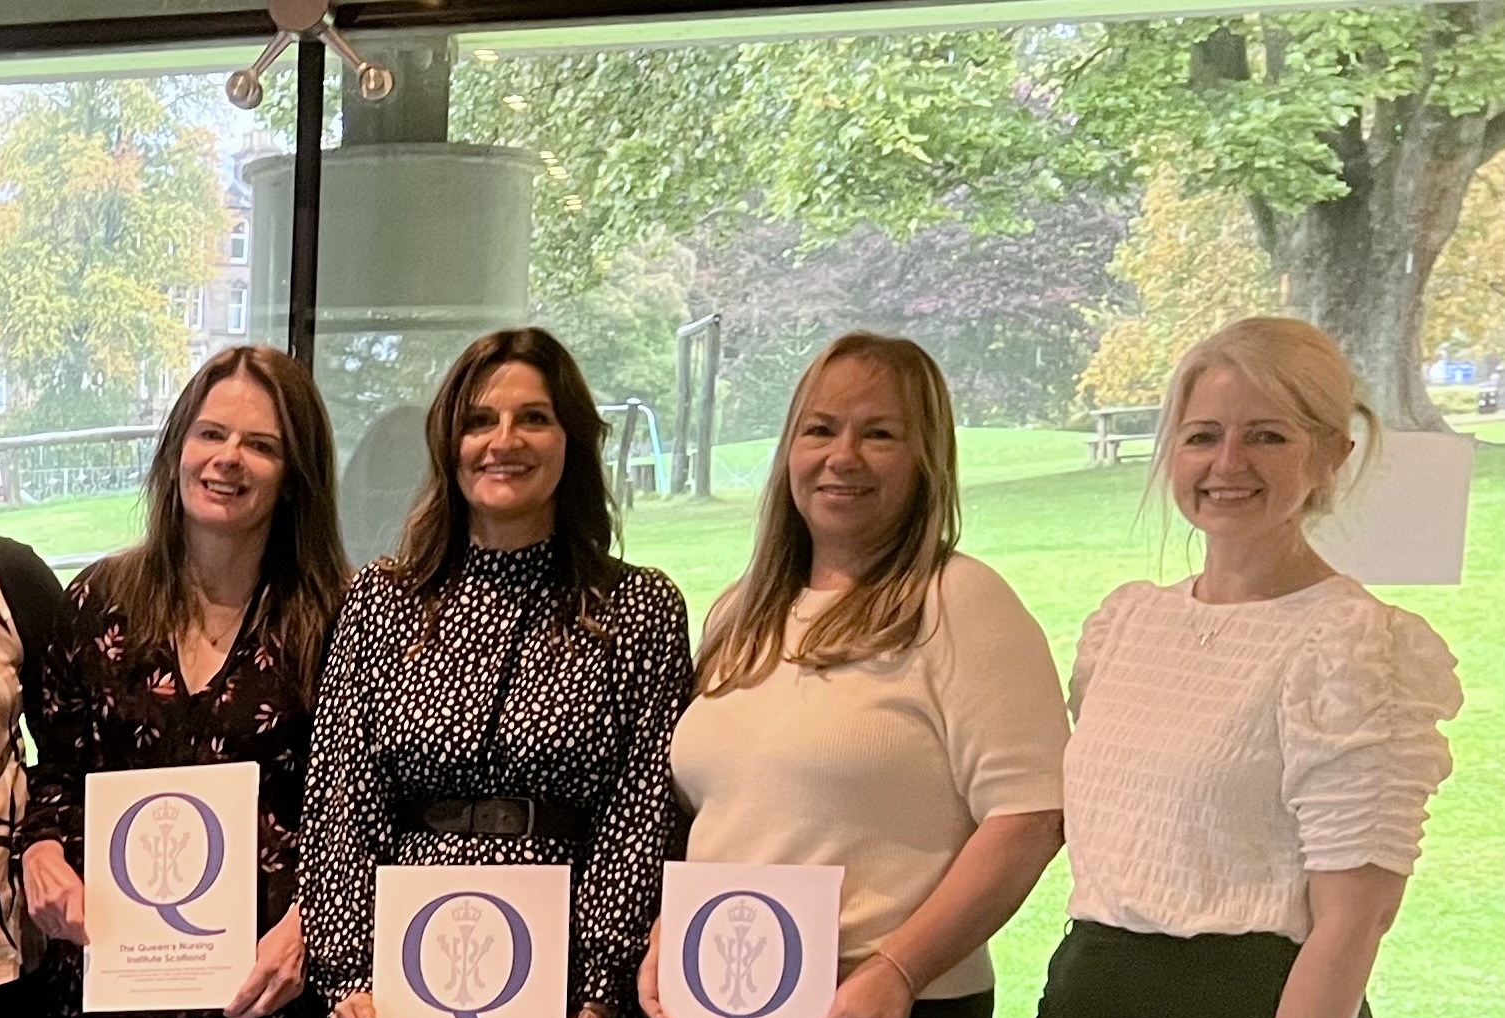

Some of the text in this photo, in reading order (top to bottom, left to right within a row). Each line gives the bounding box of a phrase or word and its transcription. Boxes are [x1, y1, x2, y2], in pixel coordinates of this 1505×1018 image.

[109, 792, 226, 936] Q
[120, 944, 135, 952] The
[179, 941, 214, 951] Nursing
[127, 953, 206, 964] Institute Scotland
